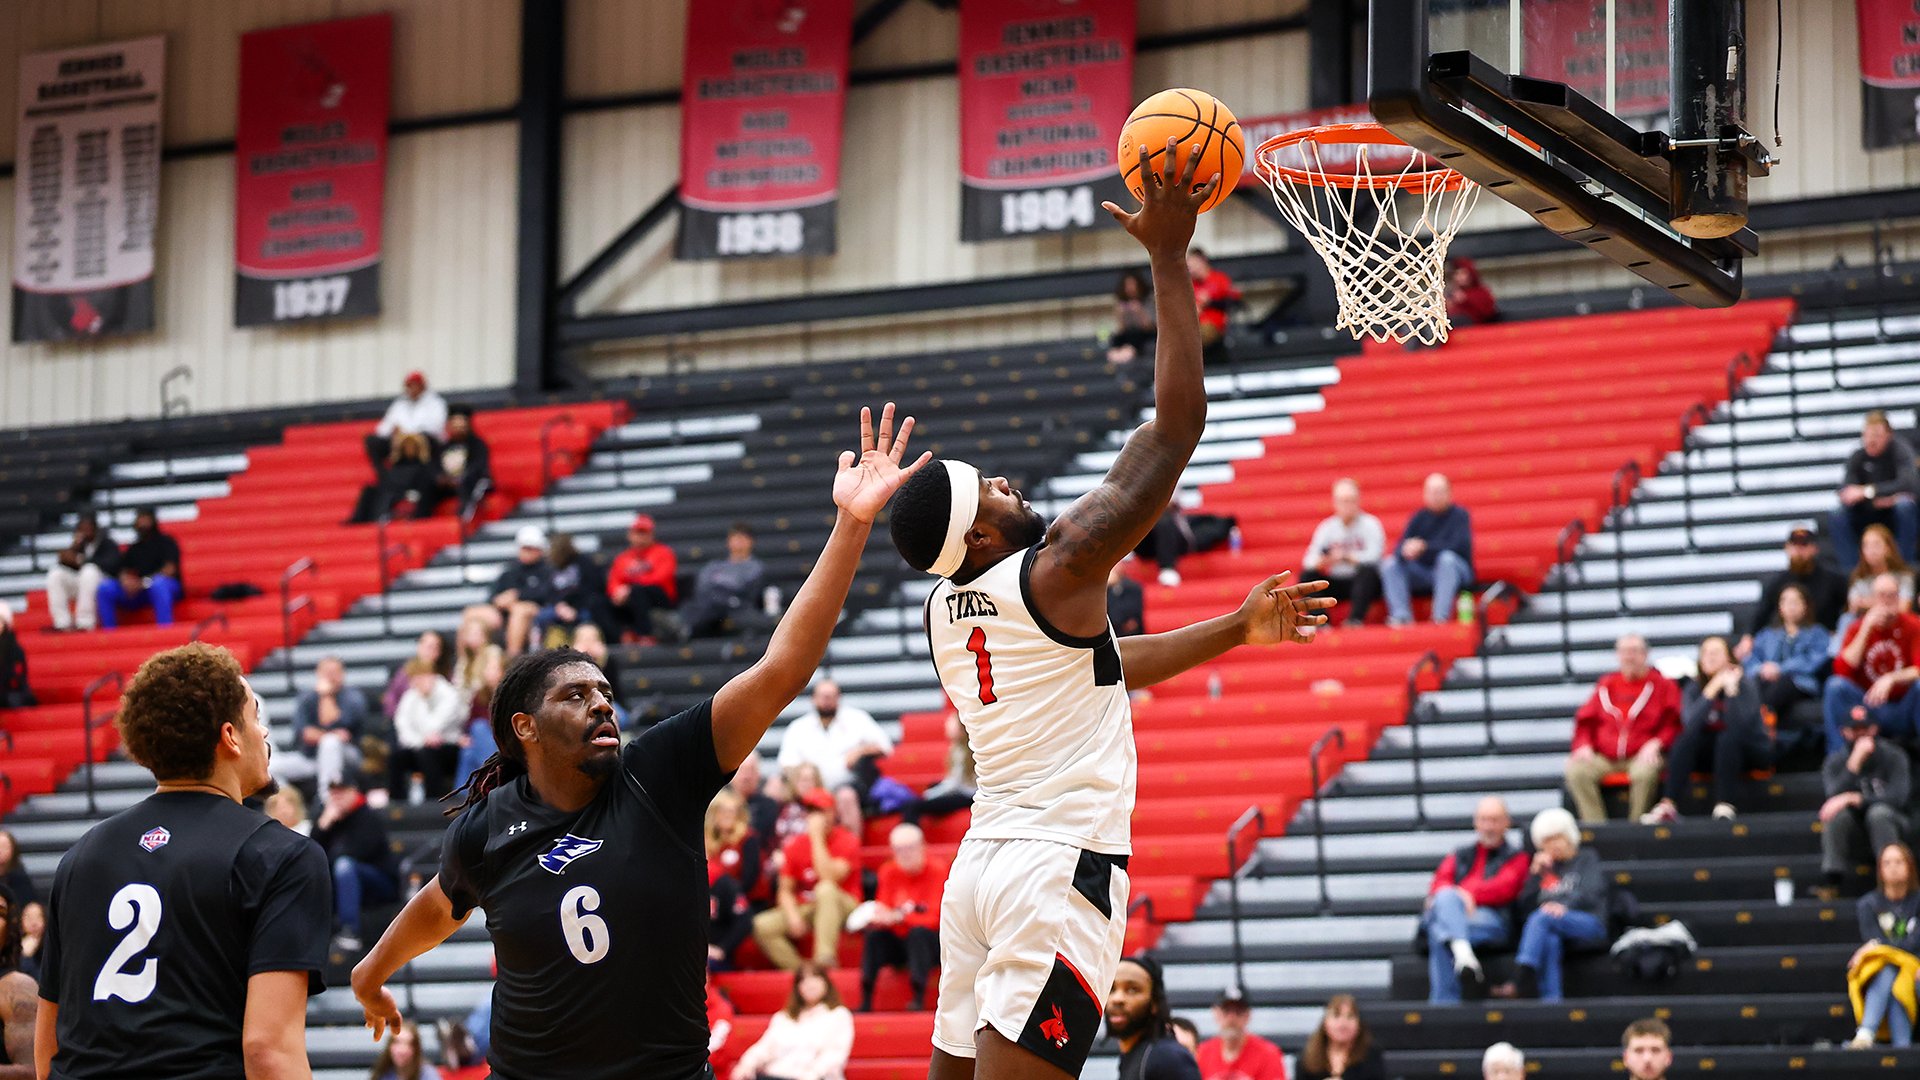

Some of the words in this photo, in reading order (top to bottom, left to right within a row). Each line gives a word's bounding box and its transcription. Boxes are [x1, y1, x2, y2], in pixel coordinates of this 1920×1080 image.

[1002, 186, 1095, 234] 1984
[717, 212, 804, 256] 1938
[273, 276, 351, 321] 1937
[945, 590, 998, 624] FIKES
[966, 626, 998, 706] 1
[143, 834, 167, 843] MIAA
[92, 882, 163, 1005] 2
[559, 884, 612, 965] 6
